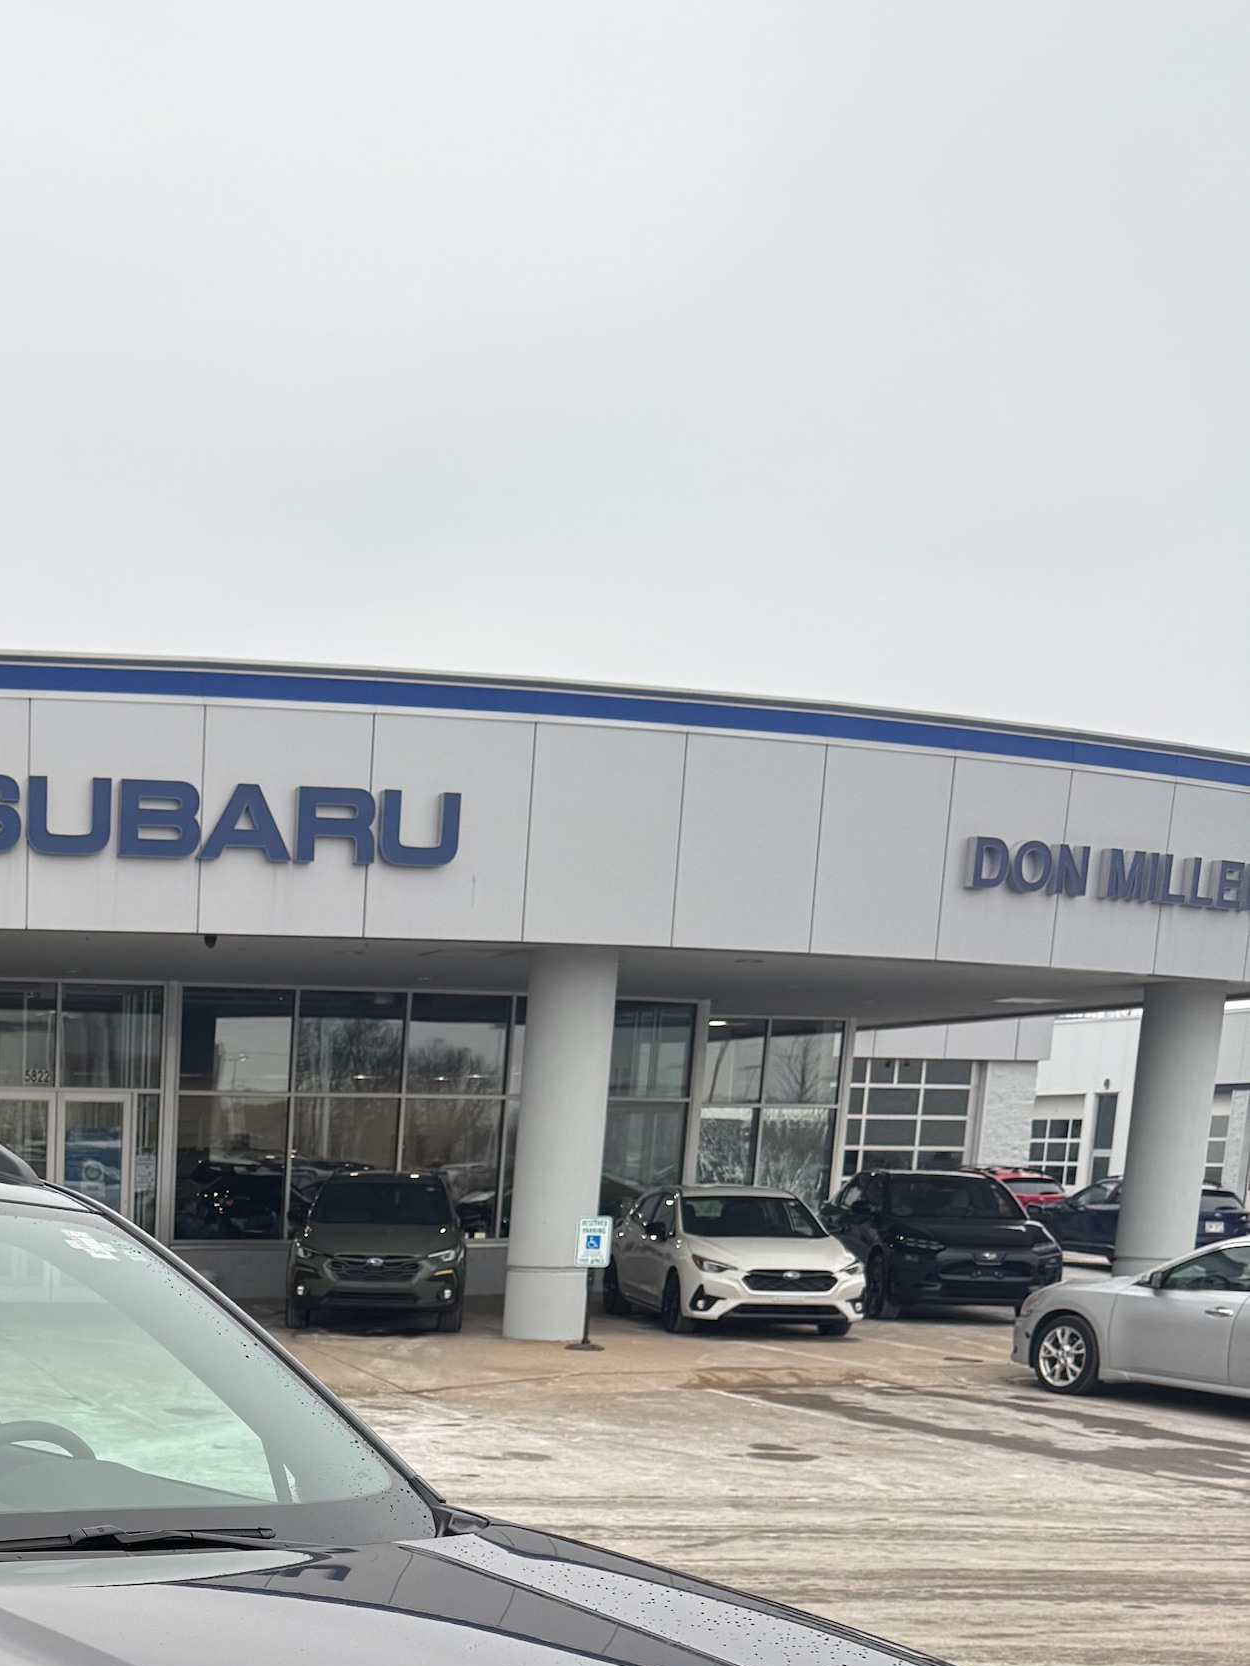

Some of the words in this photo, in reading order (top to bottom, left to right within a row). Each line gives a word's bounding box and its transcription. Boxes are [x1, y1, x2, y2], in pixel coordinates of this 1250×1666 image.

[964, 836, 1091, 896] DON
[1100, 848, 1250, 911] MILLE
[24, 1070, 50, 1083] 5822
